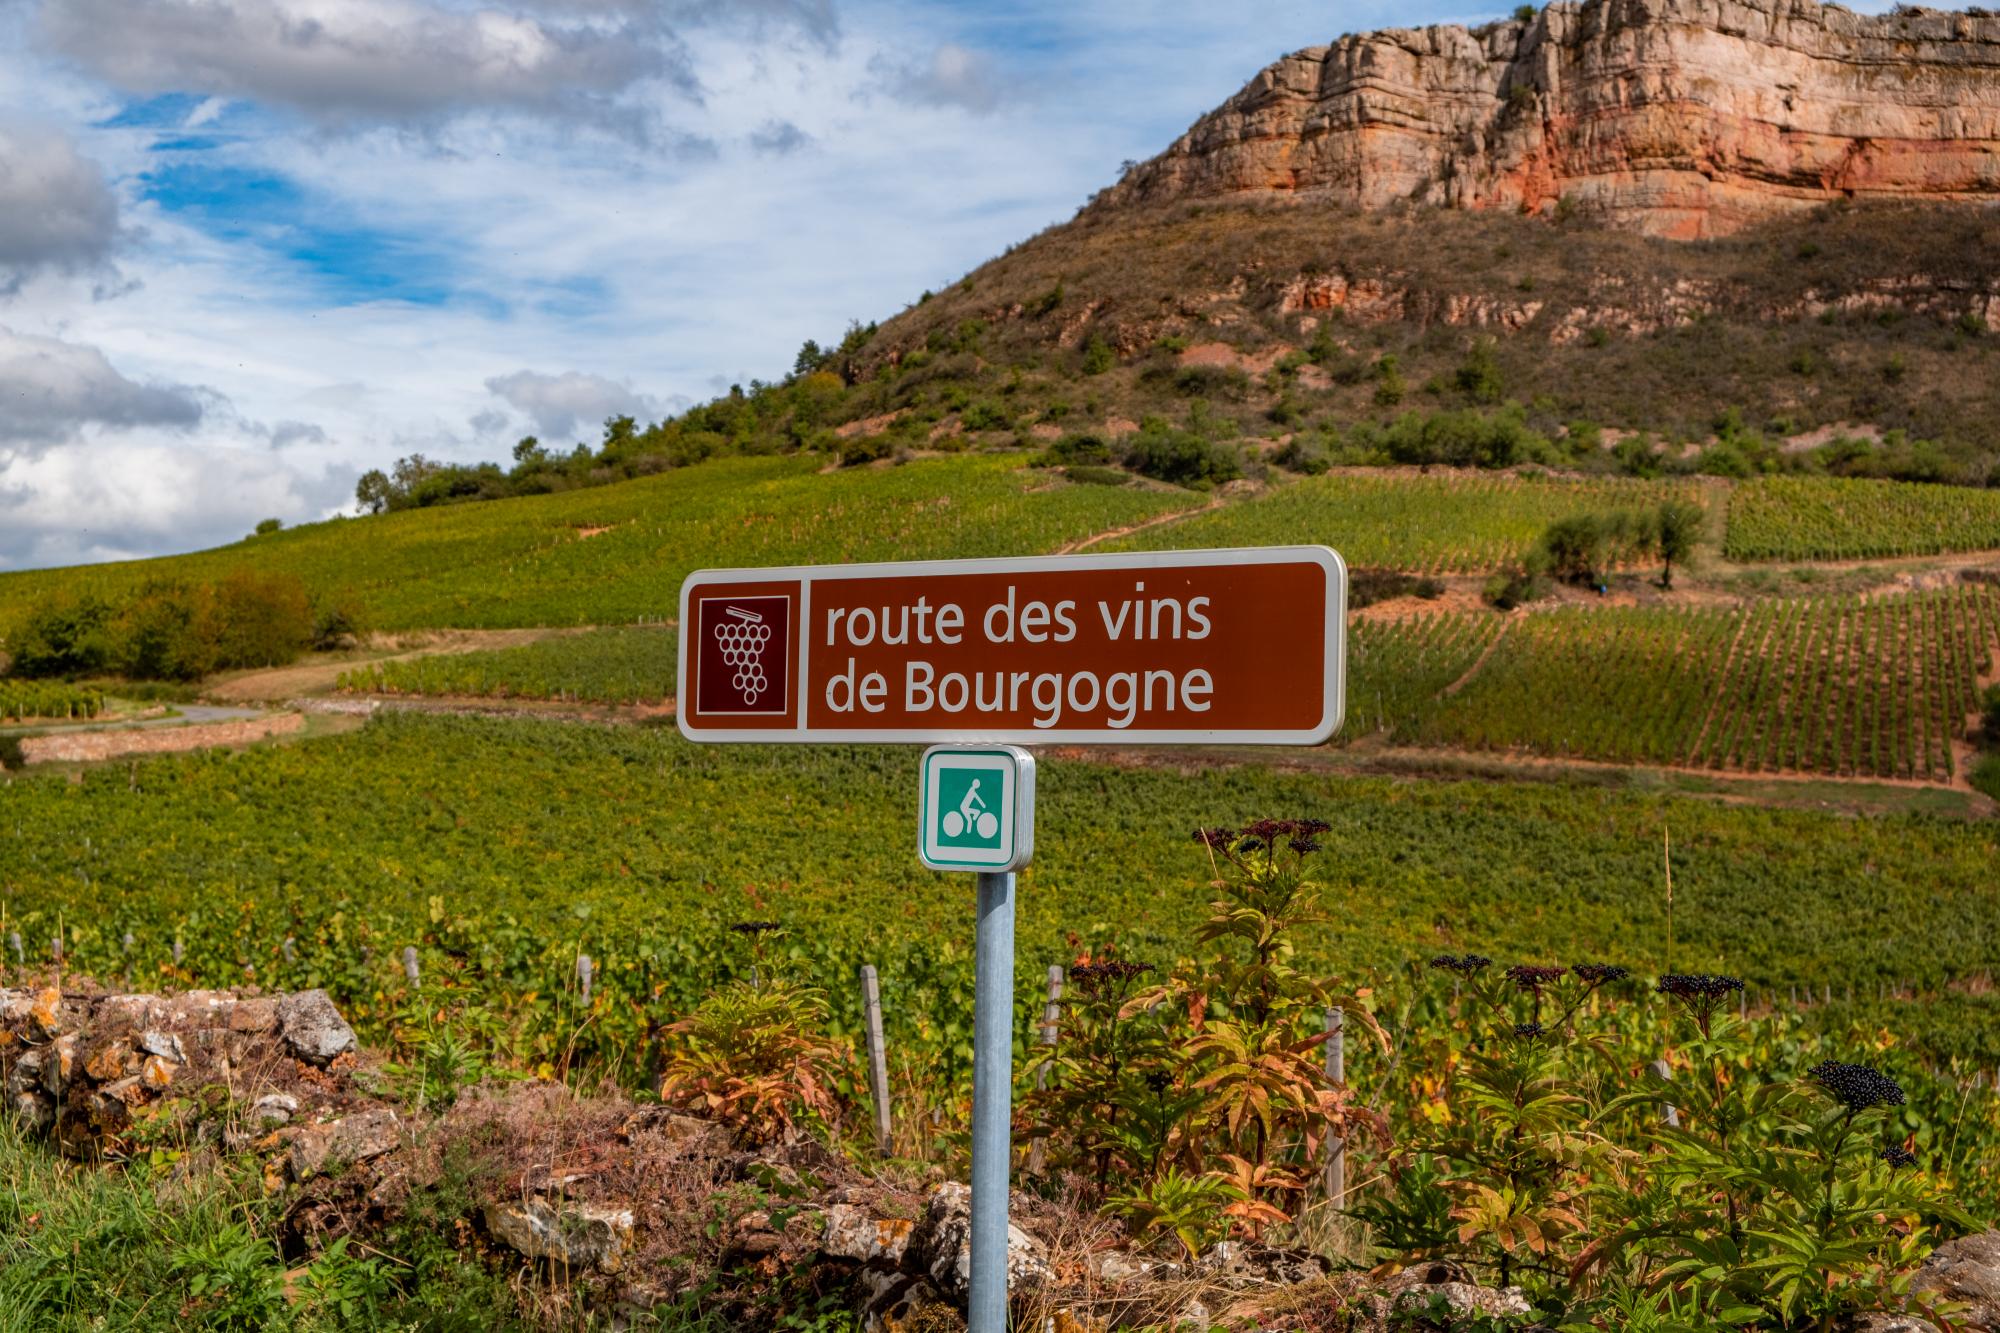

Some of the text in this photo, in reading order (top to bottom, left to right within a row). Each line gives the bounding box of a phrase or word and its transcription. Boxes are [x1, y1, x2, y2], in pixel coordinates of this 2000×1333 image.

[826, 581, 1211, 646] route des vins
[825, 657, 1214, 729] de Bourgogne
